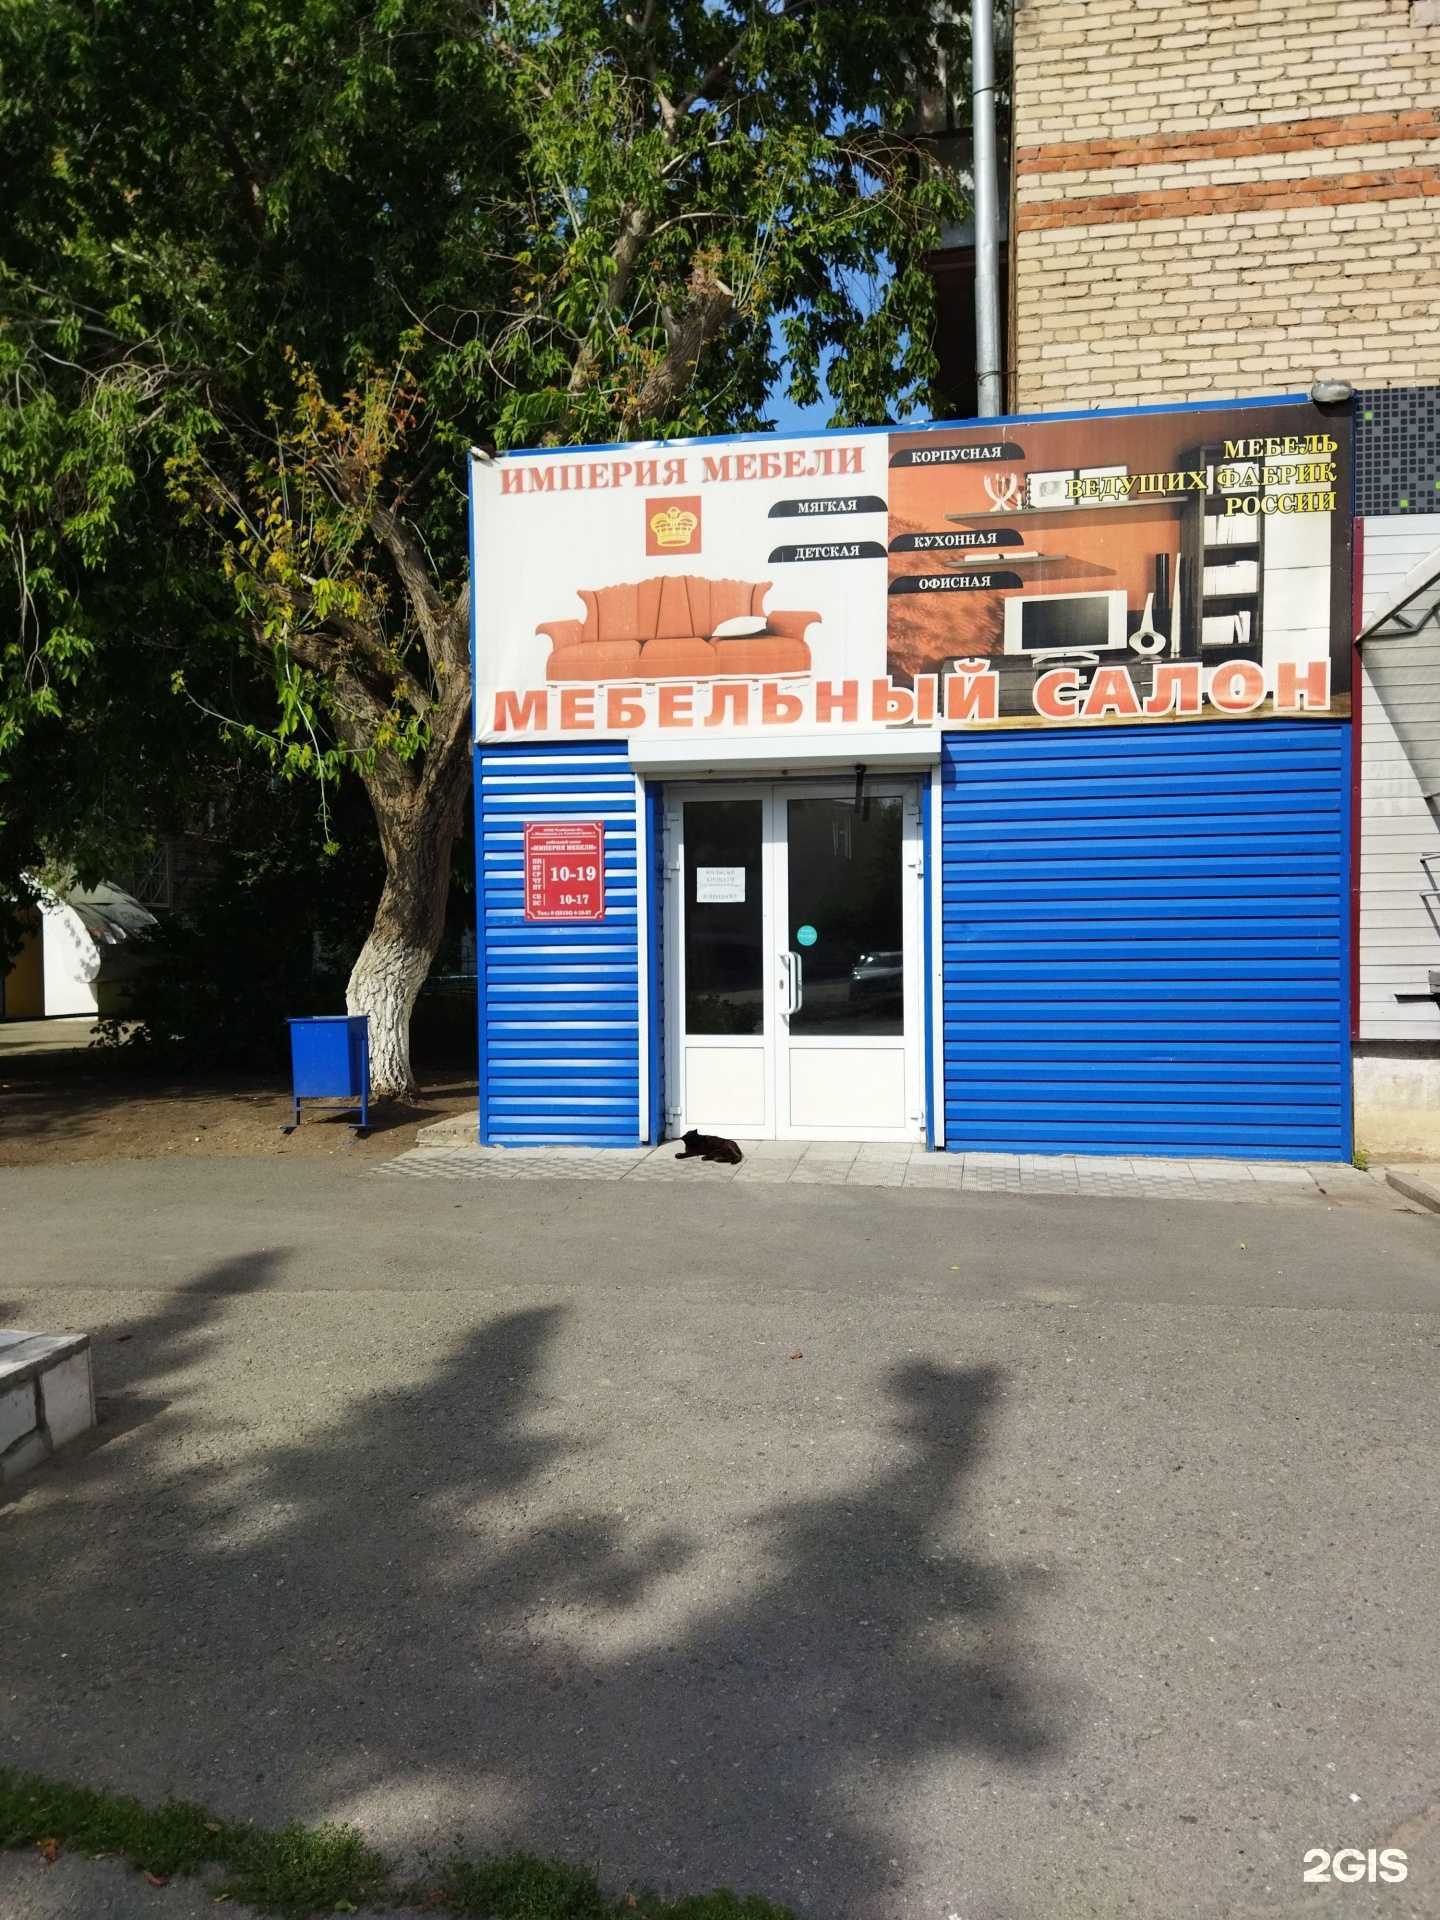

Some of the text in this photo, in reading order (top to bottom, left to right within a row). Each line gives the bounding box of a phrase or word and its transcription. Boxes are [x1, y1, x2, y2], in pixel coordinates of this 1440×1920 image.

[911, 446, 1002, 464] КОРПУСНАЯ
[1223, 434, 1338, 459] МЕБЕЛЬ
[500, 446, 866, 495] ИМПЕРИЯ МЕБЕЛИ
[1065, 462, 1338, 501] ВЕДУЩИХ ФАБРИК
[797, 499, 858, 514] МЯГКАЯ
[1225, 492, 1337, 517] РОССИИ
[913, 532, 998, 549] КУХОННАЯ
[794, 545, 861, 561] ДЕТСКАЯ
[918, 576, 992, 590] ОФИСНАЯ
[493, 657, 1333, 732] МЕБЕЛЬНЫЙ САЛОН
[550, 866, 597, 882] 10-19
[559, 894, 590, 905] 10-17
